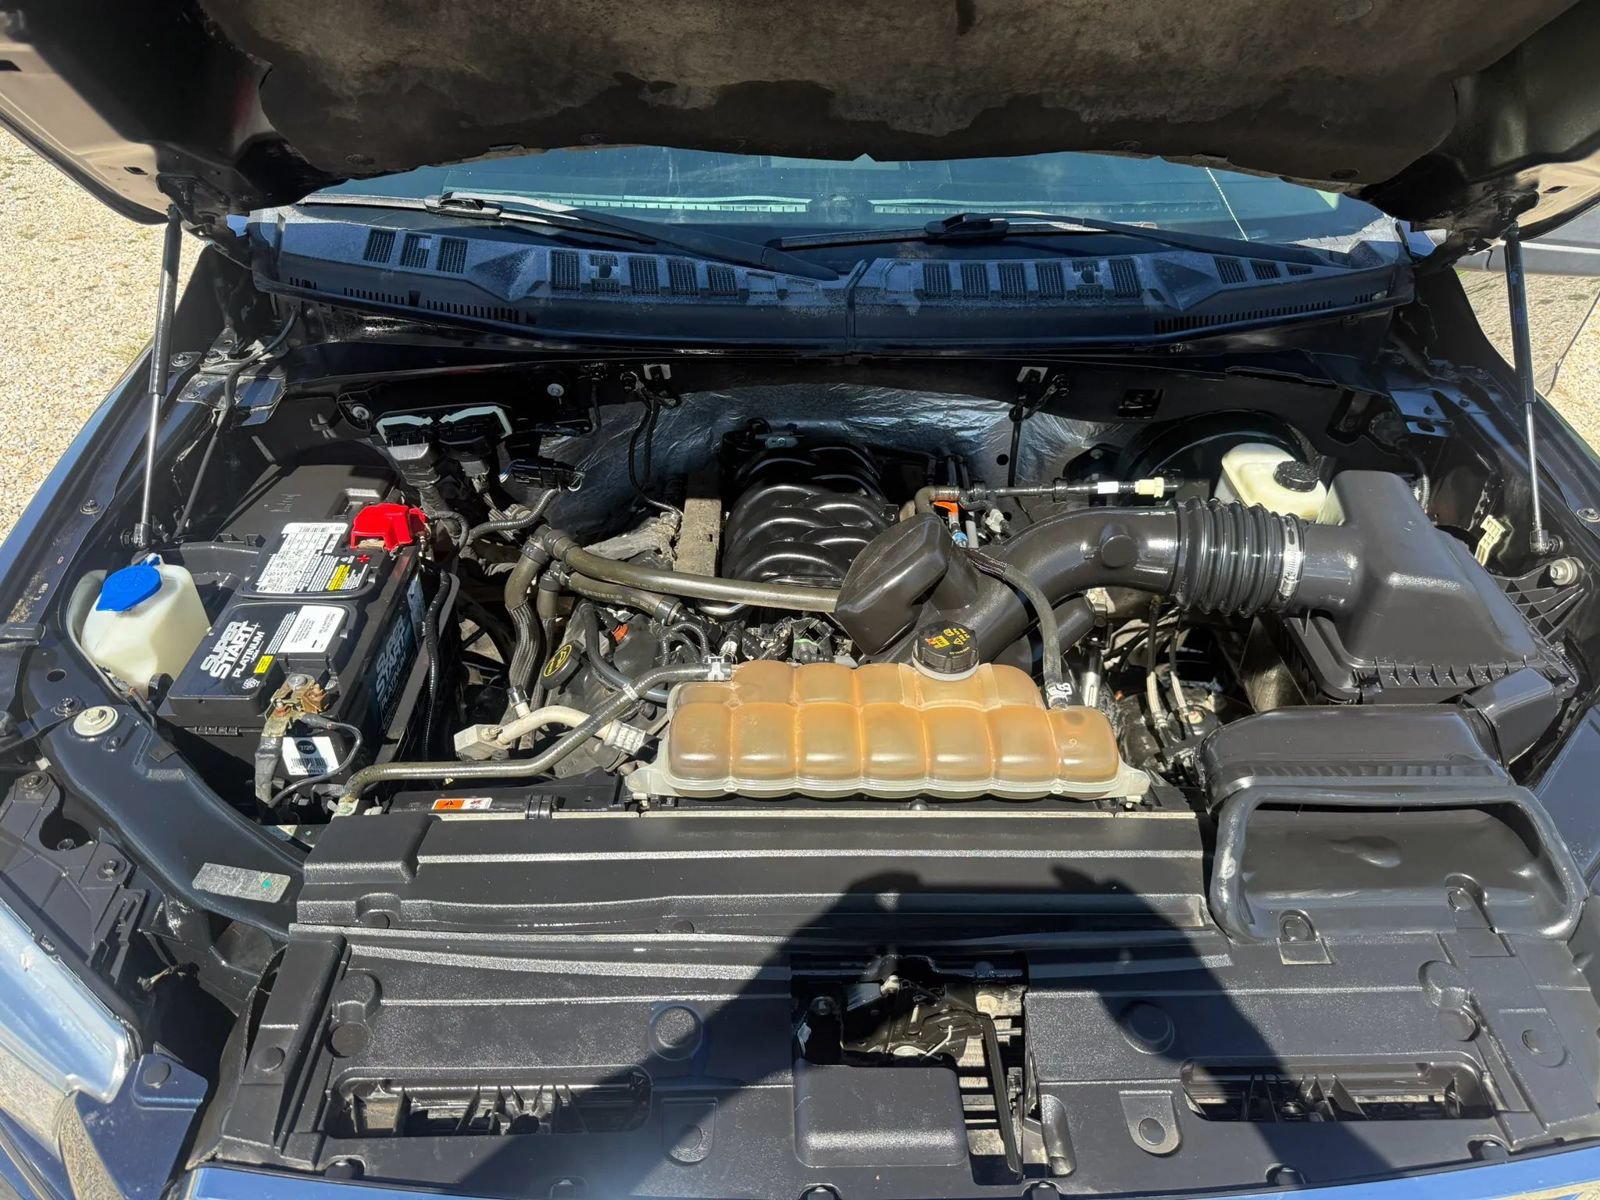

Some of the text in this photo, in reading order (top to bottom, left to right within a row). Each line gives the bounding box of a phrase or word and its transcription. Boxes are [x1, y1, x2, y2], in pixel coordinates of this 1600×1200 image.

[200, 620, 244, 672] SUPER
[209, 620, 256, 680] START
[232, 631, 266, 679] PLATINUM
